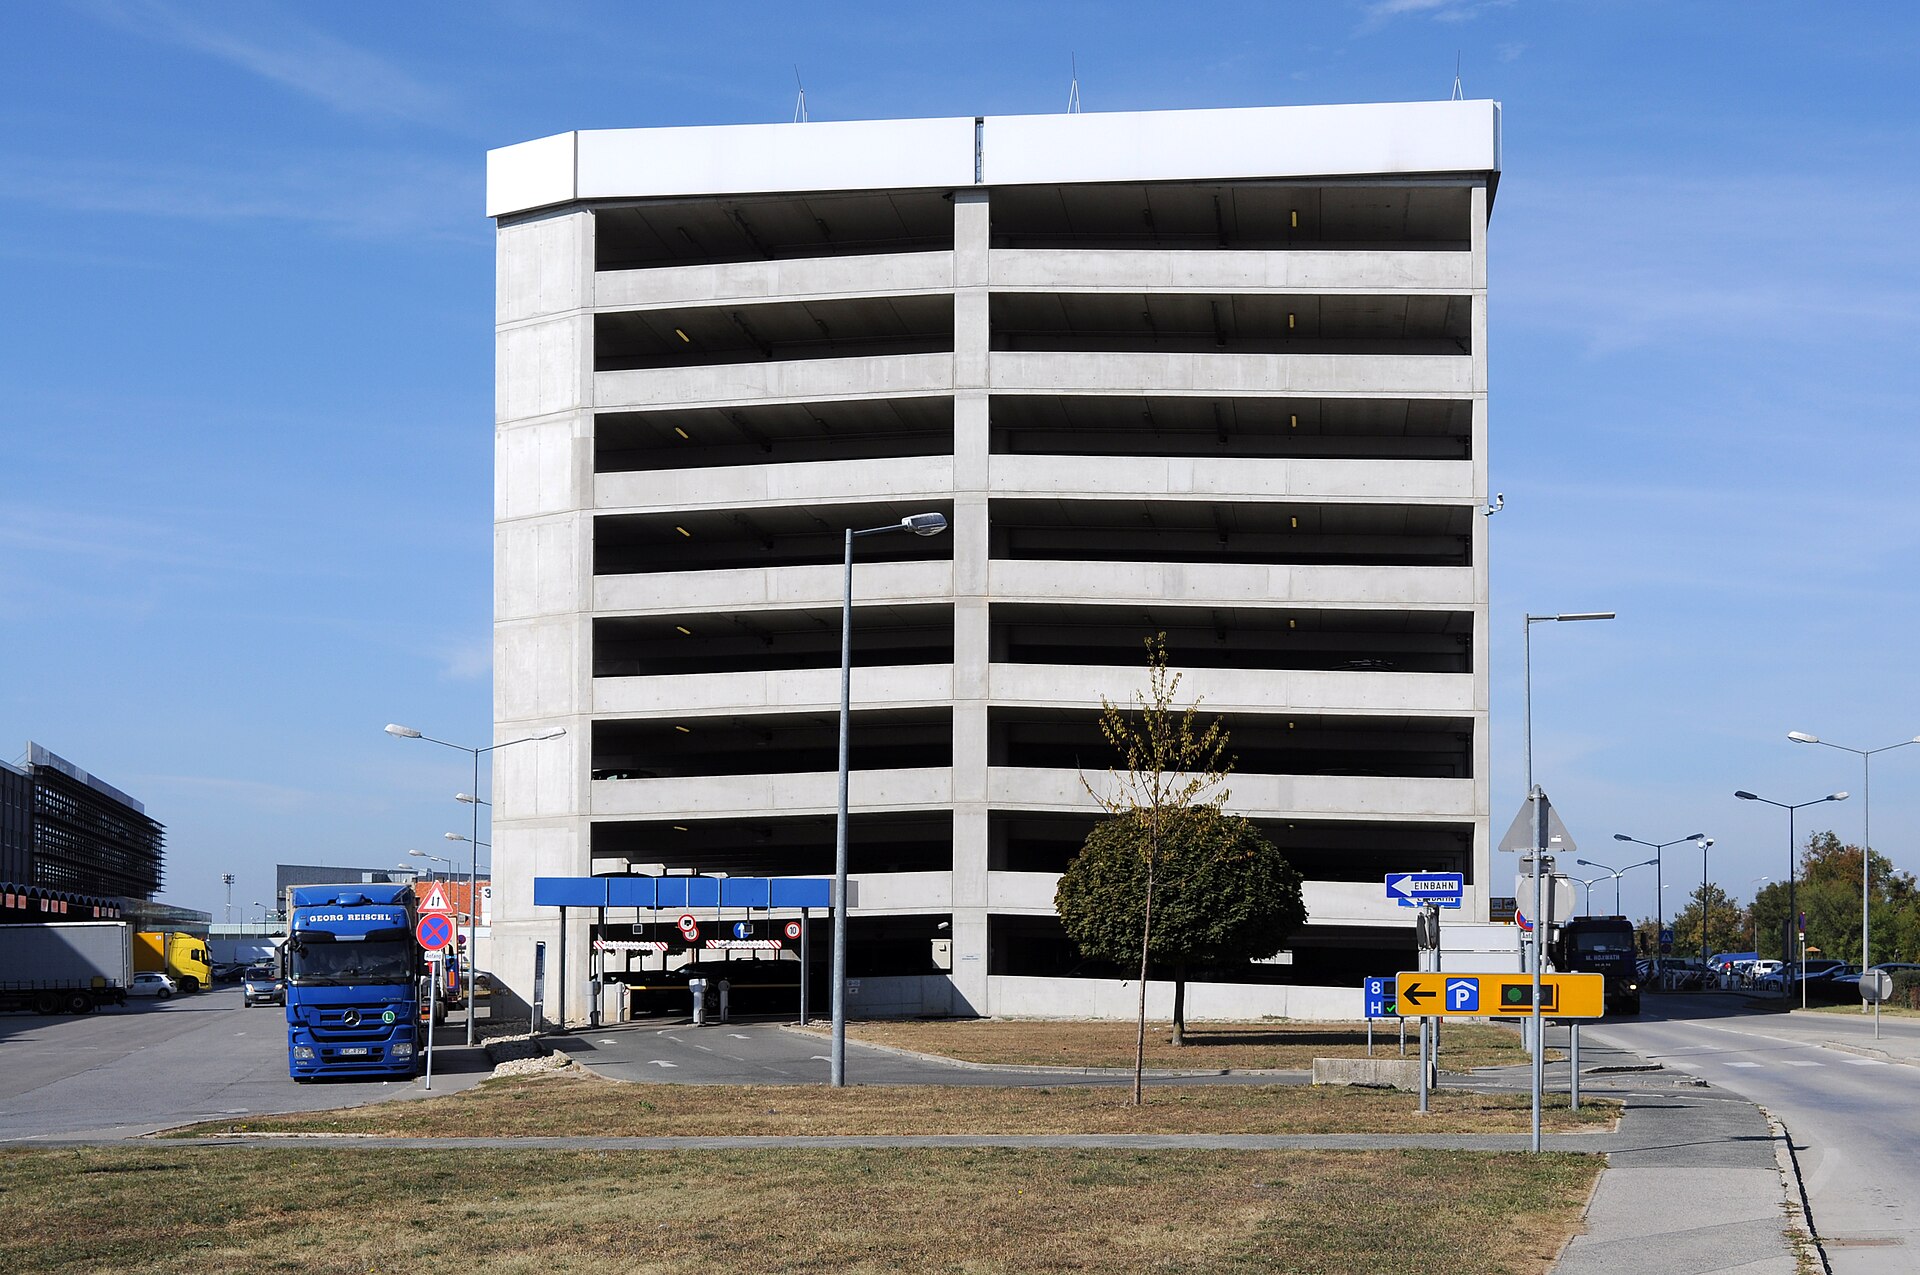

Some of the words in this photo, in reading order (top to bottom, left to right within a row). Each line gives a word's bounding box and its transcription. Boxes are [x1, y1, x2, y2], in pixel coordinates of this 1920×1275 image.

[1414, 881, 1454, 890] EINBAHN
[309, 914, 344, 922] GEORG
[347, 913, 391, 921] REISCHL
[789, 926, 797, 935] 10
[1371, 981, 1381, 994] 8
[1455, 988, 1470, 1009] P
[1370, 1001, 1381, 1014] H
[385, 1013, 391, 1021] L
